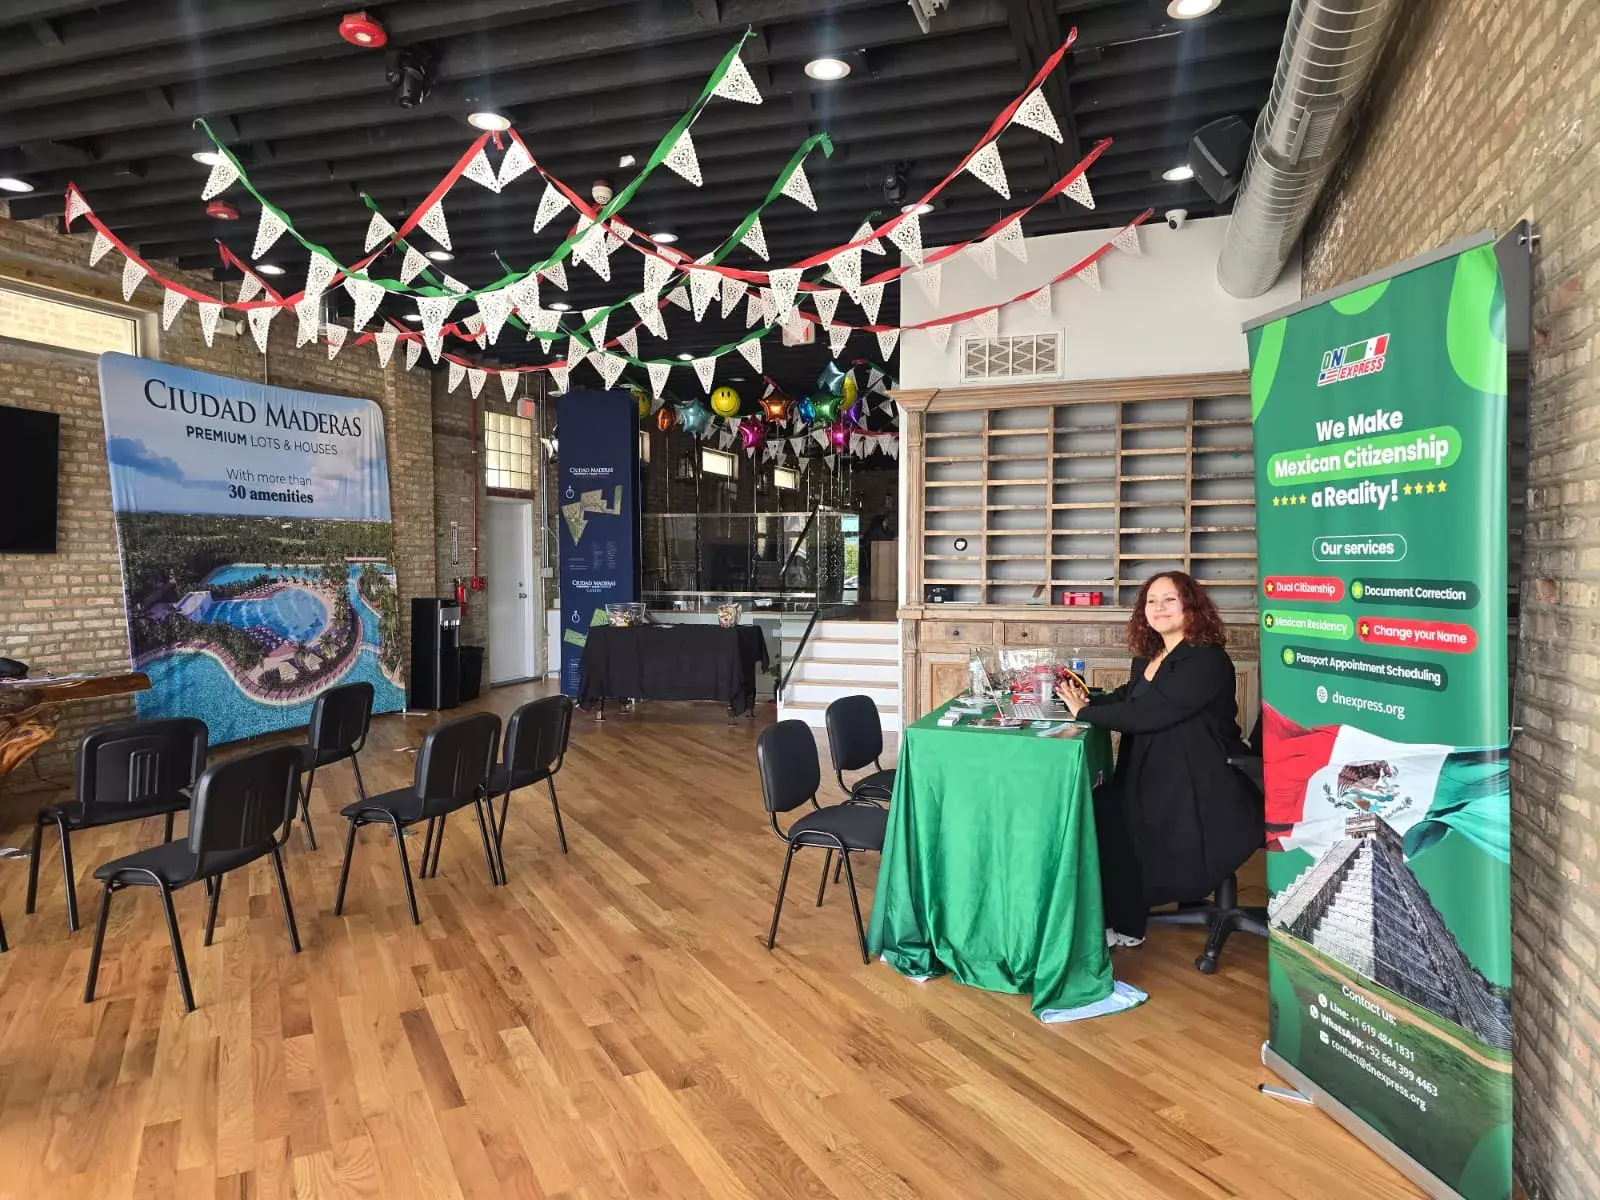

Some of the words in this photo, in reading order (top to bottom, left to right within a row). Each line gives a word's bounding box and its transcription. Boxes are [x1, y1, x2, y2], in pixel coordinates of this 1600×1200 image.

[1322, 347, 1344, 371] DN
[1339, 357, 1385, 381] EXPRESS
[144, 379, 256, 423] CIUDAD
[266, 402, 362, 437] MADERAS
[186, 425, 247, 446] PREMIUM
[251, 435, 280, 450] LOTS
[284, 439, 291, 451] &
[294, 441, 338, 455] HOUSES
[1316, 419, 1346, 442] We
[1348, 409, 1403, 437] Make
[1274, 453, 1341, 478] Mexican
[1344, 434, 1449, 469] Citizenship
[226, 467, 255, 482] With
[258, 473, 285, 485] more
[288, 474, 312, 486] than
[229, 484, 247, 500] 30
[249, 488, 314, 504] amenities
[1324, 479, 1398, 511] Reality!
[1320, 541, 1341, 555] Our
[1344, 540, 1395, 555] services
[1276, 582, 1293, 592] Dual
[1294, 583, 1336, 596] Citizenship
[1364, 585, 1415, 598] Document
[1415, 587, 1466, 601] Correction
[1275, 616, 1306, 628] Mexican
[1307, 619, 1348, 635] Residency
[1373, 624, 1412, 641] Change
[1414, 629, 1435, 643] your
[1436, 629, 1468, 644] Name
[1296, 652, 1328, 667] Passport
[1329, 659, 1385, 675] Appointment
[1386, 666, 1441, 686] Scheduling
[1332, 691, 1405, 721] dnexpress.org
[1341, 985, 1381, 1016] Contact
[1382, 1010, 1397, 1026] us:
[1329, 1001, 1349, 1021] Line:
[1350, 1016, 1359, 1028] +1
[1361, 1022, 1376, 1037] 619
[1378, 1032, 1393, 1048] 484
[1394, 1042, 1414, 1062] 1831
[1320, 1013, 1364, 1049] WhatsApp:
[1366, 1045, 1381, 1060] +52
[1381, 1053, 1397, 1071] 664
[1398, 1063, 1415, 1081] 399
[1415, 1076, 1438, 1097] 4463
[1331, 1040, 1427, 1112] contact@dnexpress.org
